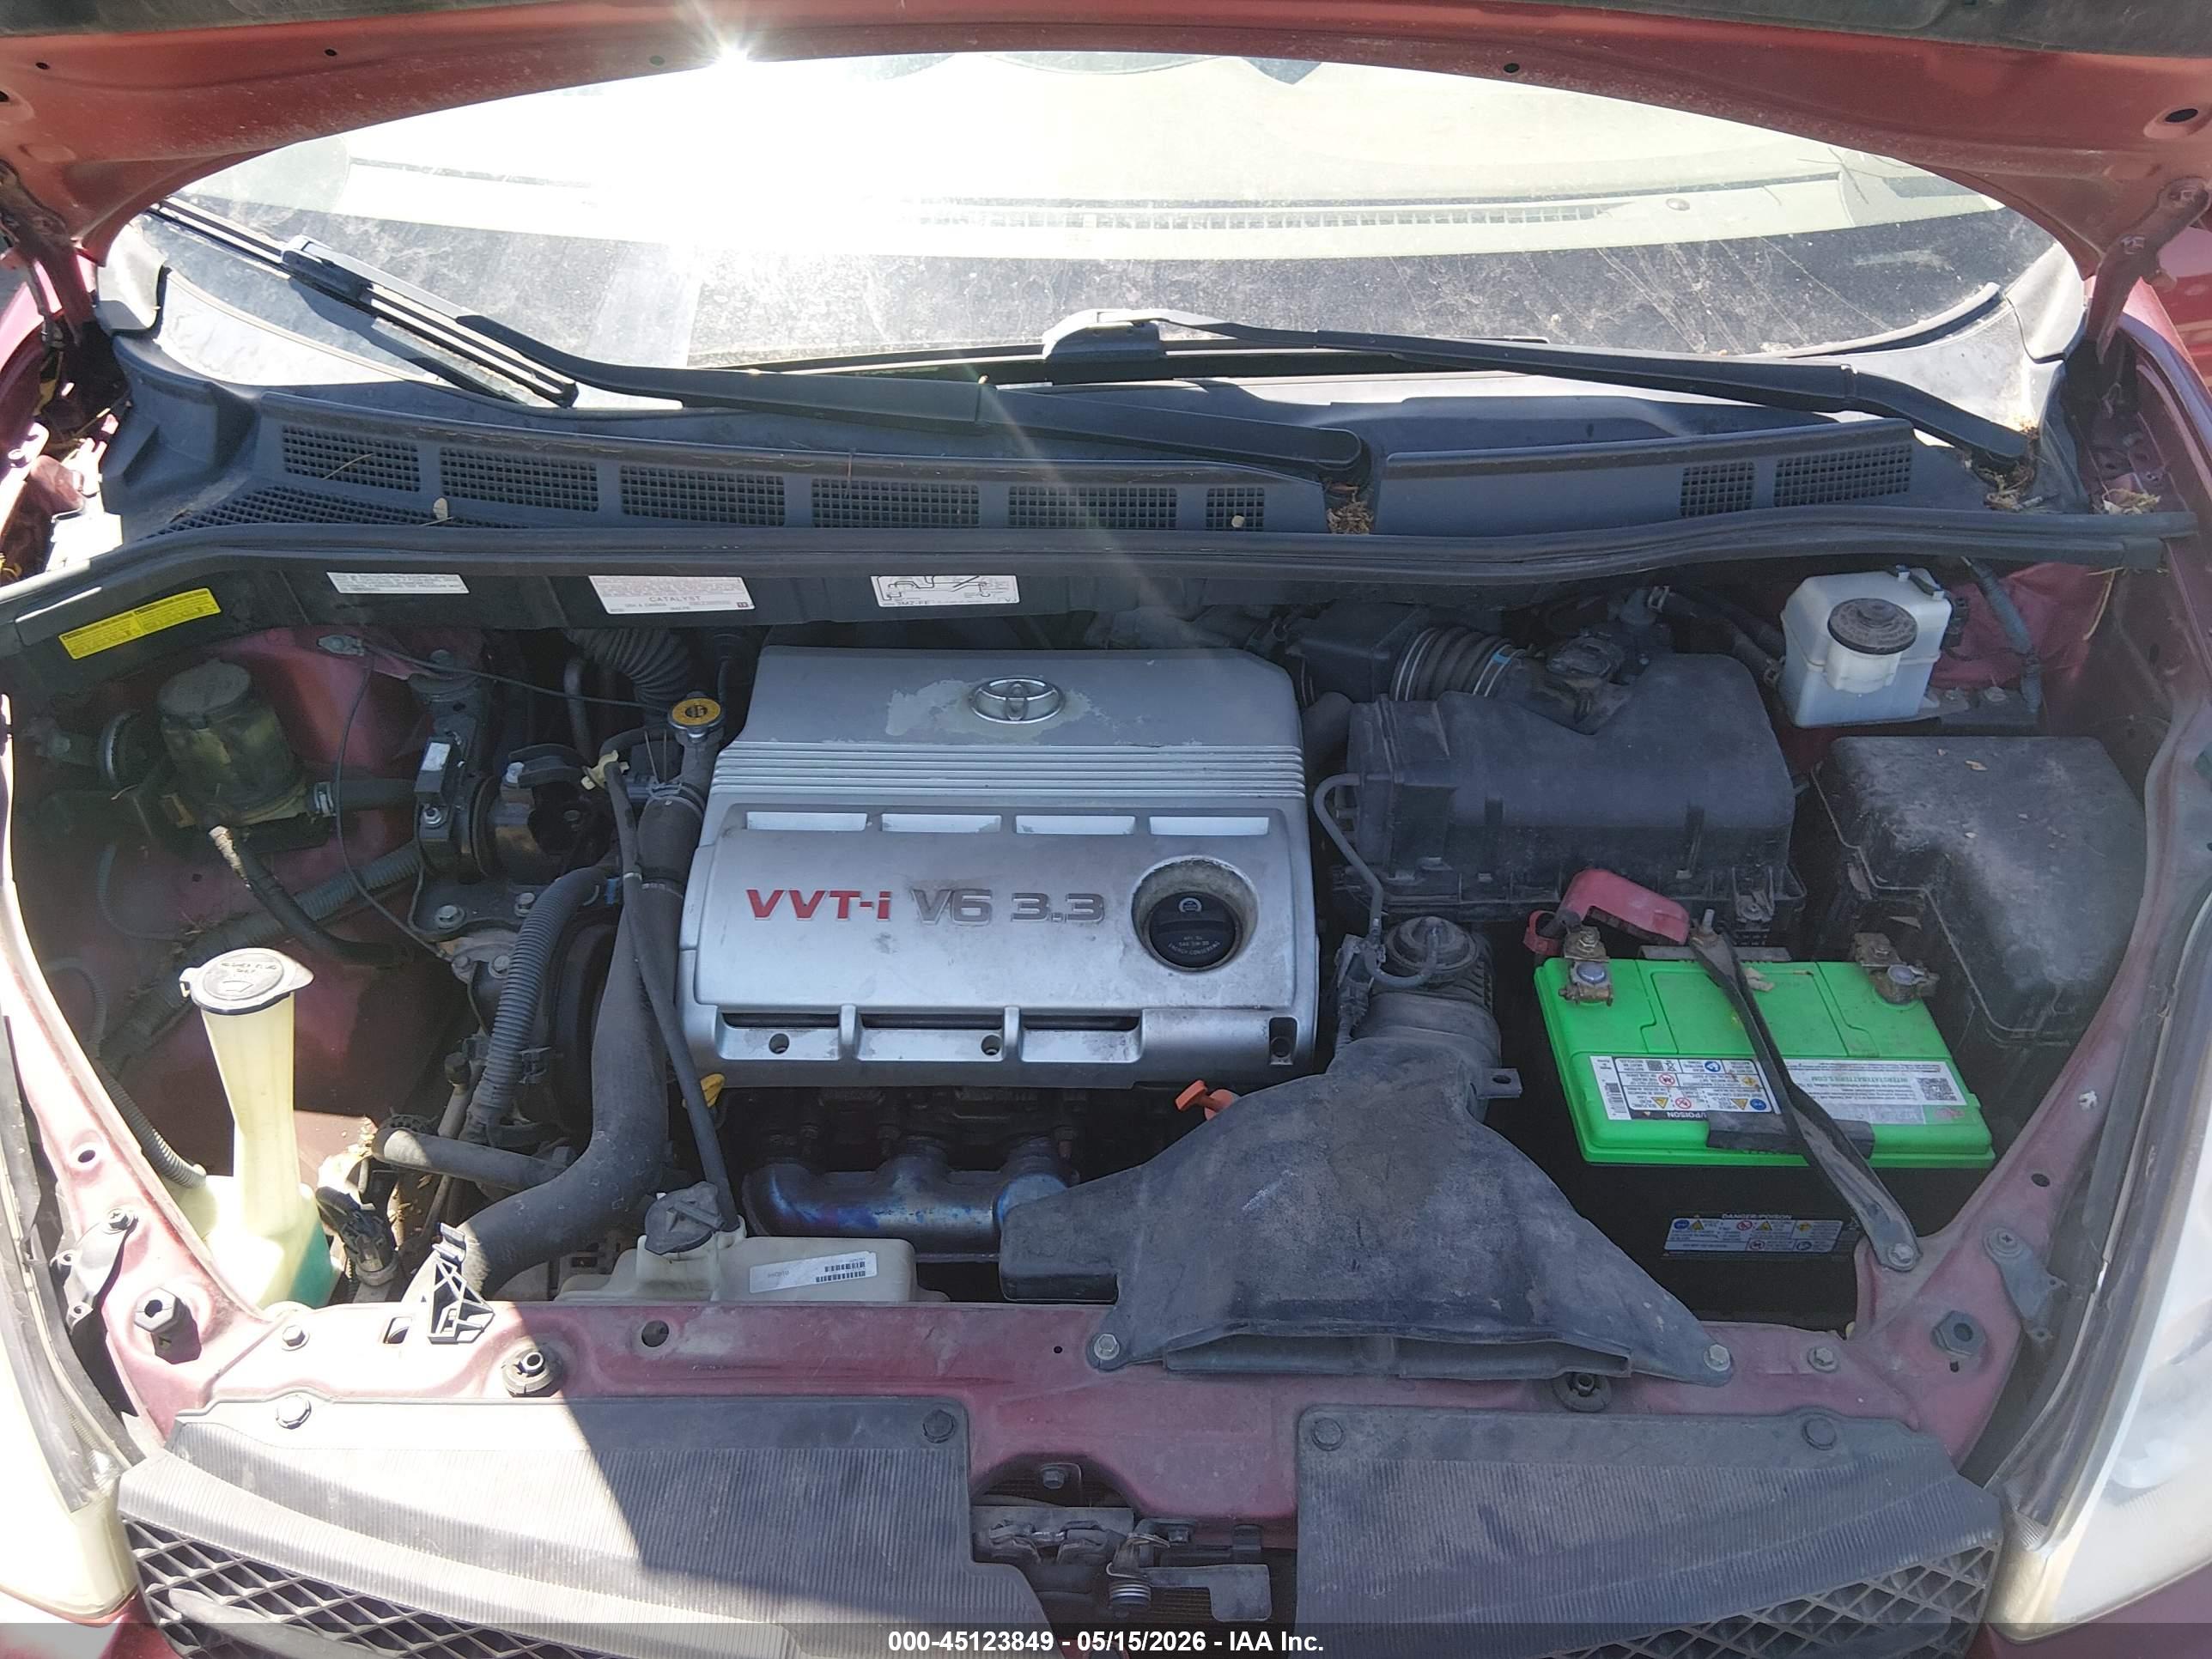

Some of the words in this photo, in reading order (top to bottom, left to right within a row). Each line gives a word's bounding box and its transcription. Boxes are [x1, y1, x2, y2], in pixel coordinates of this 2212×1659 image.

[745, 888, 893, 922] VVT-i
[910, 888, 994, 927] V6
[1010, 891, 1106, 925] 3.3
